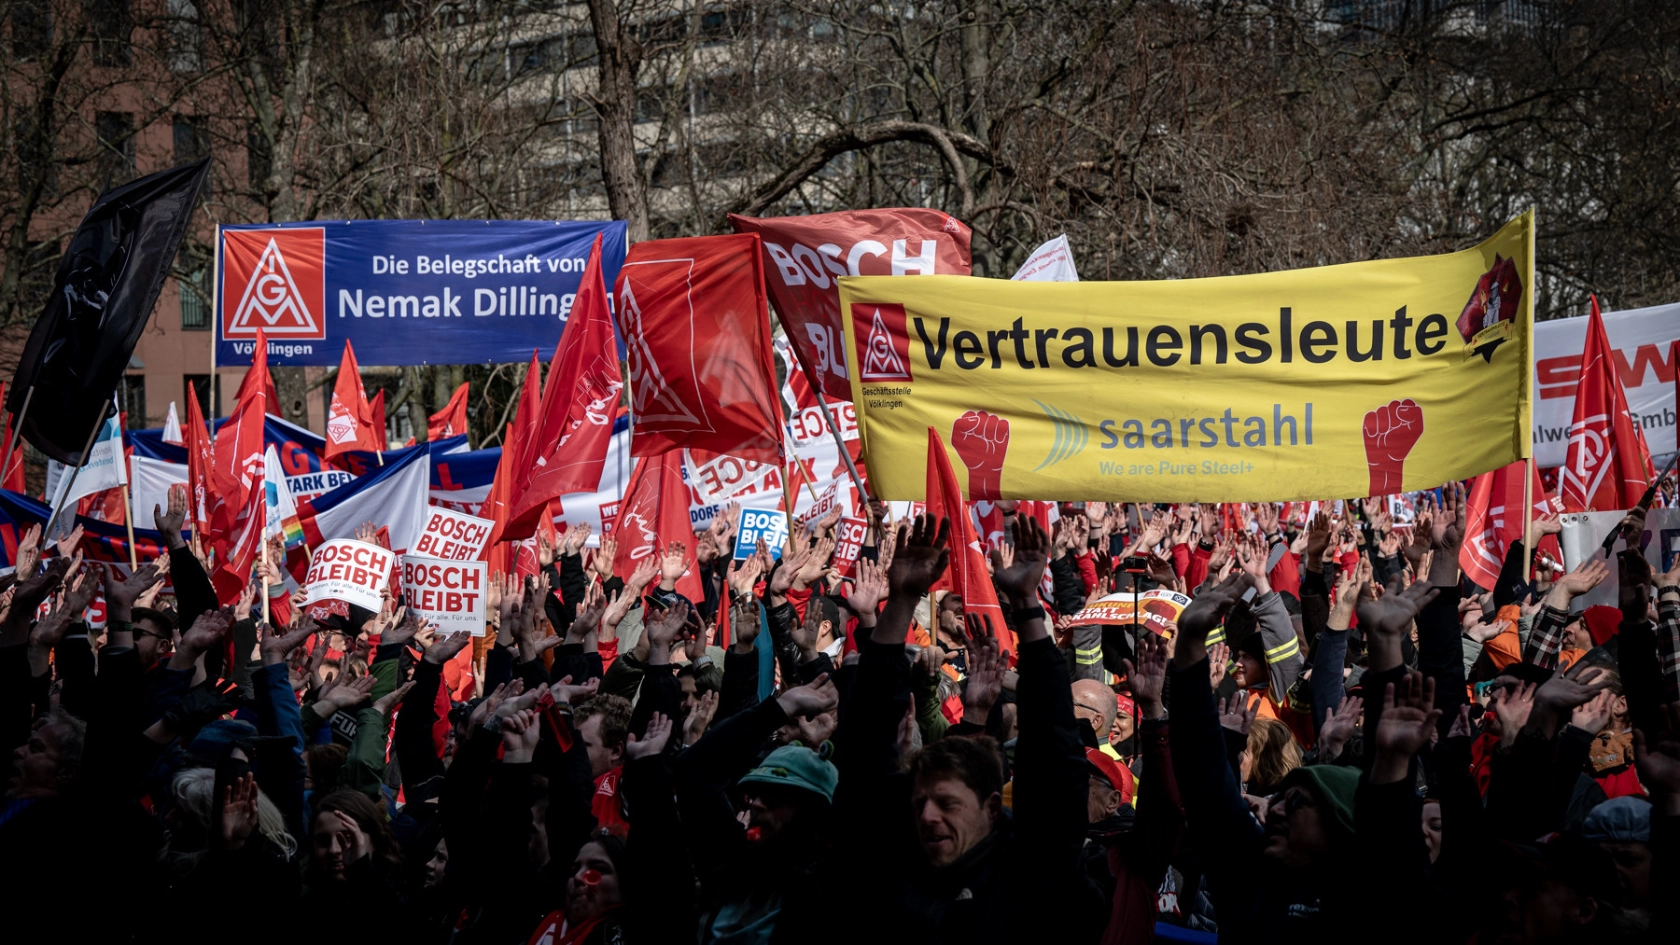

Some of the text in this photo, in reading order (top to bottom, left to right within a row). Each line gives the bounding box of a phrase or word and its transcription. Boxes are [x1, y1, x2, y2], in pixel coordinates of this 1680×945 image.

[372, 253, 586, 279] Die Belegschaft von
[764, 239, 937, 289] BOSCH
[338, 286, 615, 322] Nemak Dillingn
[233, 342, 313, 358] Völlingen
[912, 305, 1449, 371] Vertrauensleute
[861, 386, 912, 396] Geschäftsstelle
[868, 399, 903, 410] Völklingen
[1099, 402, 1313, 450] saarstahl
[1099, 459, 1254, 475] We are Pure Steel+
[285, 472, 325, 494] TARK
[426, 513, 488, 545] BOSCH
[743, 512, 790, 534] BOSC
[311, 544, 388, 573] BOSCH
[416, 534, 478, 560] BLEIBT
[306, 563, 383, 590] BLEIBT
[405, 562, 480, 590] BOSCH
[405, 587, 479, 613] BLEIBT
